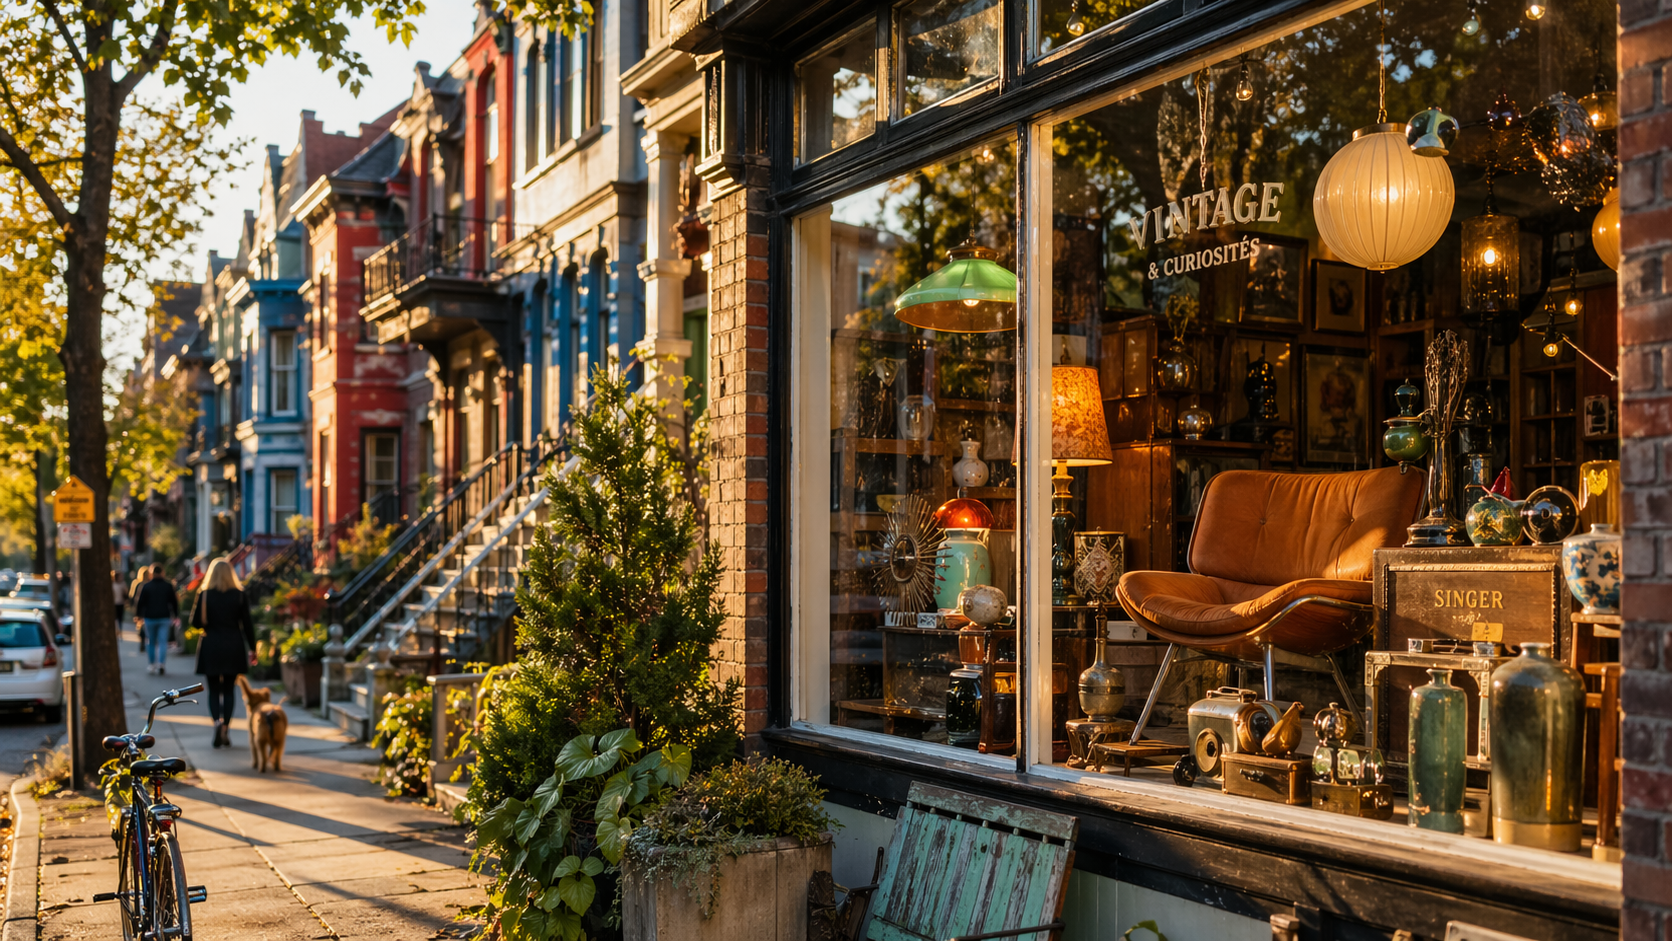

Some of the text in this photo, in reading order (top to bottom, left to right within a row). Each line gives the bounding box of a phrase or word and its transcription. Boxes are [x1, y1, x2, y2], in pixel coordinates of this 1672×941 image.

[1128, 182, 1285, 250] VINTAGE
[1148, 235, 1260, 280] & CURIOSITÉS
[1434, 589, 1504, 609] SINGER
